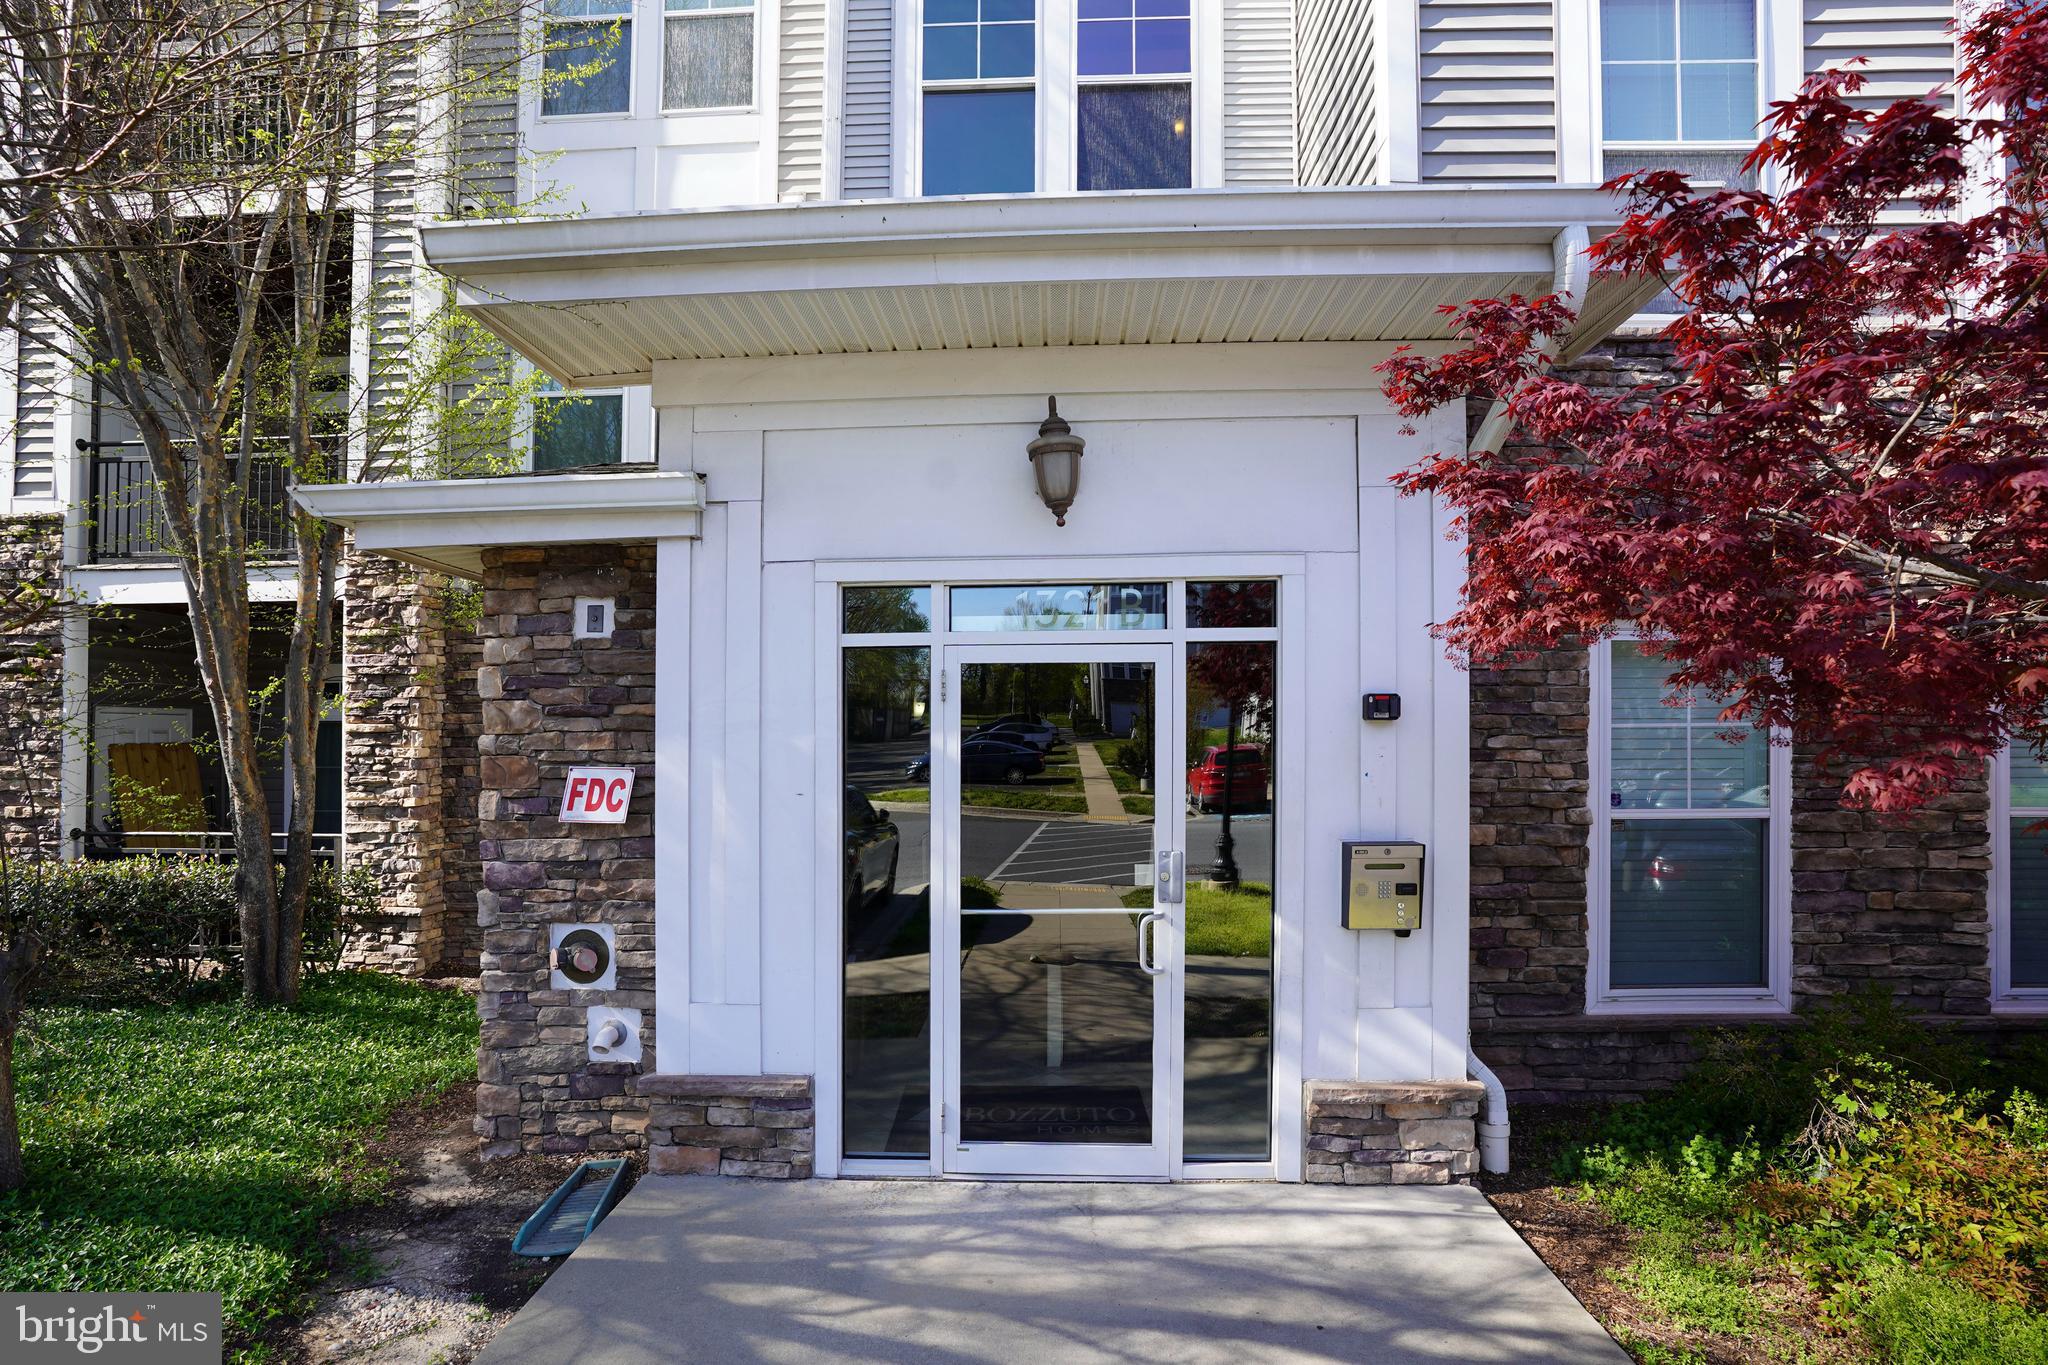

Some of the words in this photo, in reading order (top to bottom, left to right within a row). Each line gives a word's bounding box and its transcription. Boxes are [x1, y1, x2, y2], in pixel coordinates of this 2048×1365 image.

[1015, 589, 1105, 629] 1321
[1120, 588, 1145, 627] B
[566, 777, 627, 813] FDC
[964, 1106, 1137, 1122] BOZZUTO
